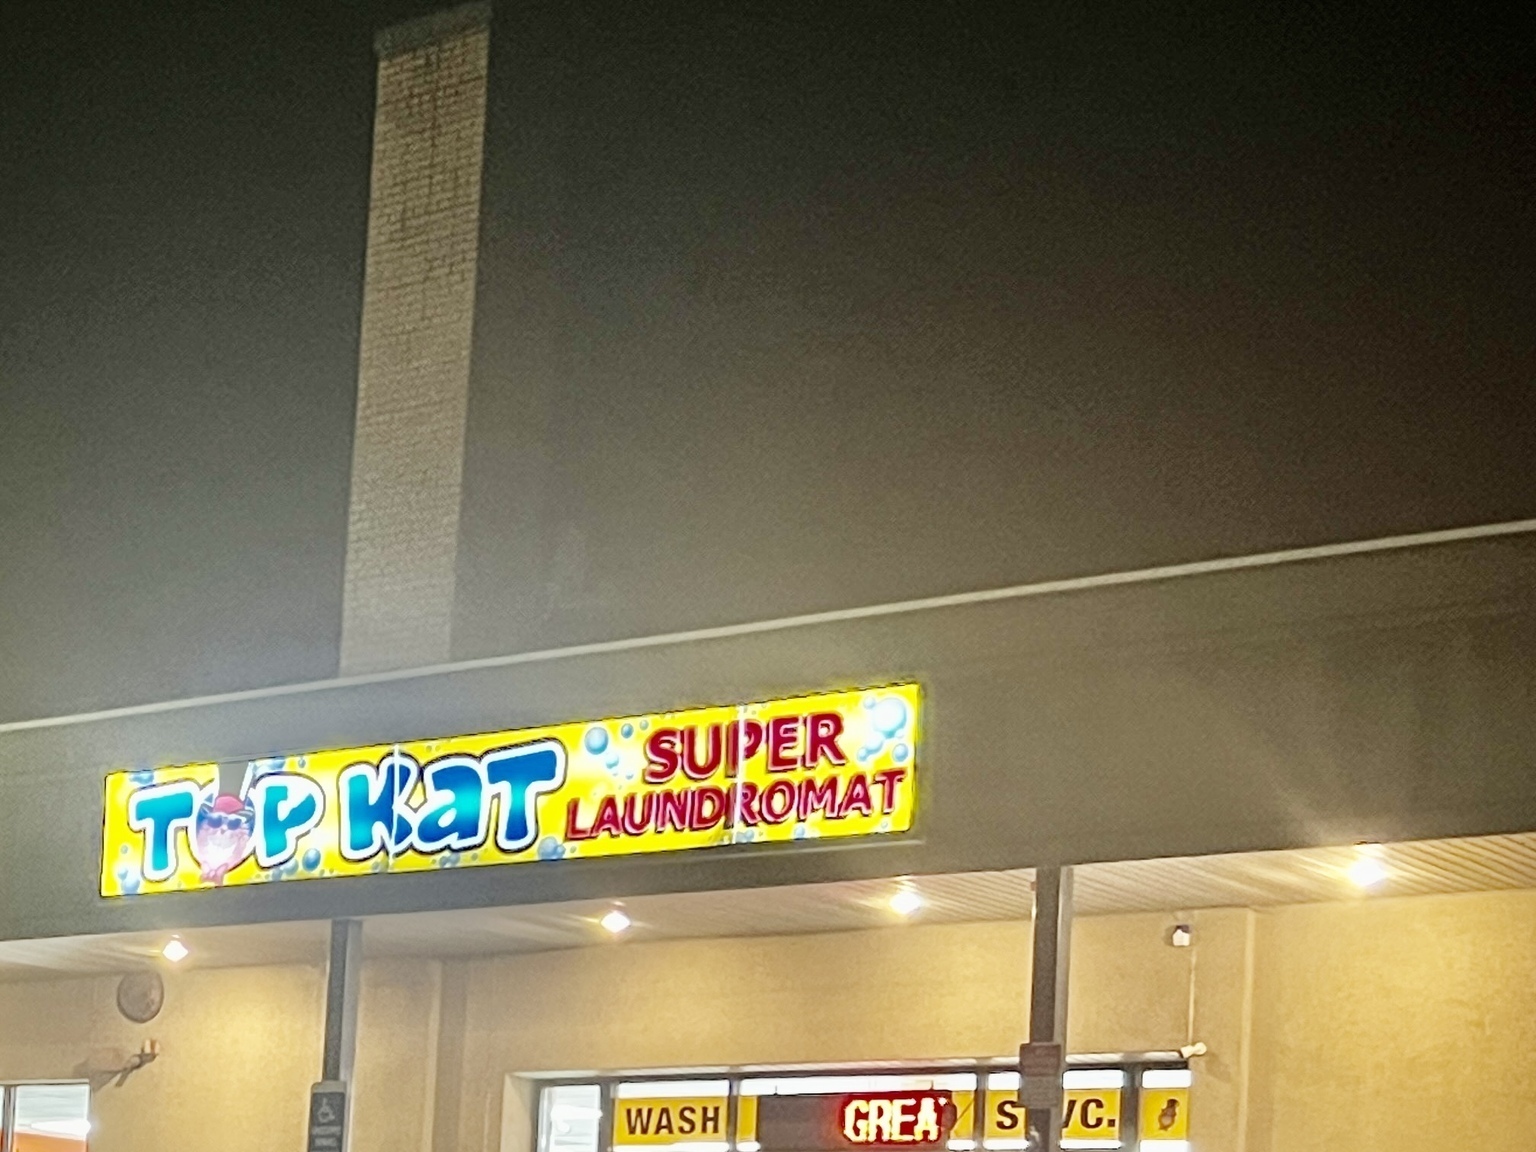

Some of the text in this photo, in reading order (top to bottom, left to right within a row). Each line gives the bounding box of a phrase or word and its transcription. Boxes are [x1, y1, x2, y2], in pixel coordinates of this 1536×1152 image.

[643, 712, 848, 784] SUPER
[565, 767, 907, 841] LAUNDROMAT
[625, 1106, 720, 1136] WASH
[843, 1096, 948, 1143] GREA
